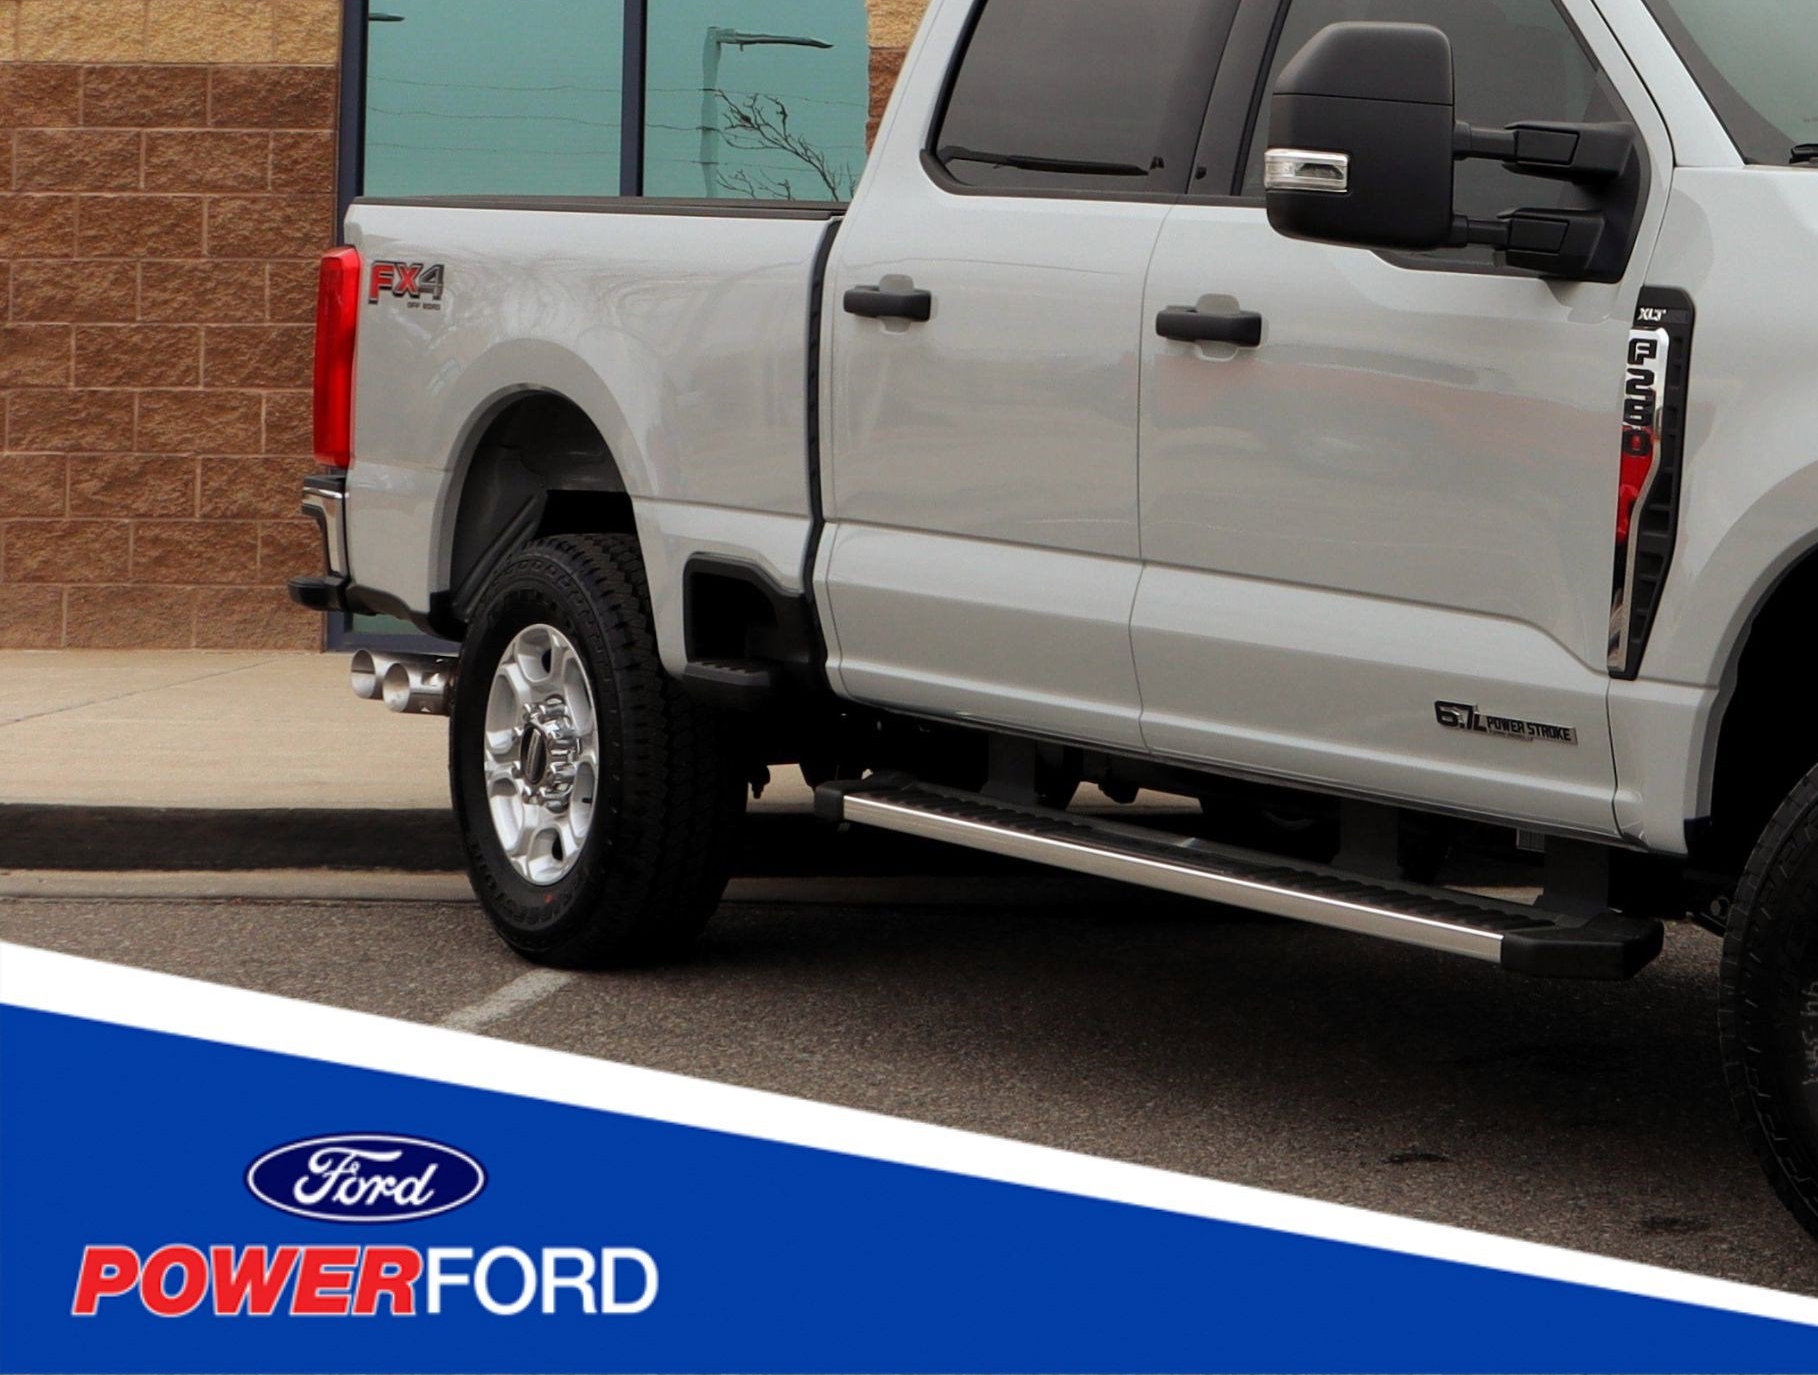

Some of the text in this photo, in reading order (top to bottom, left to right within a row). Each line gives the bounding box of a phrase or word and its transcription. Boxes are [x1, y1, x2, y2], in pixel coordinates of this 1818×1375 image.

[368, 260, 445, 305] FX4
[1637, 306, 1667, 321] XLT
[1434, 700, 1487, 733] 6.7L
[1486, 715, 1526, 734] POWER
[1526, 721, 1572, 742] STROKE
